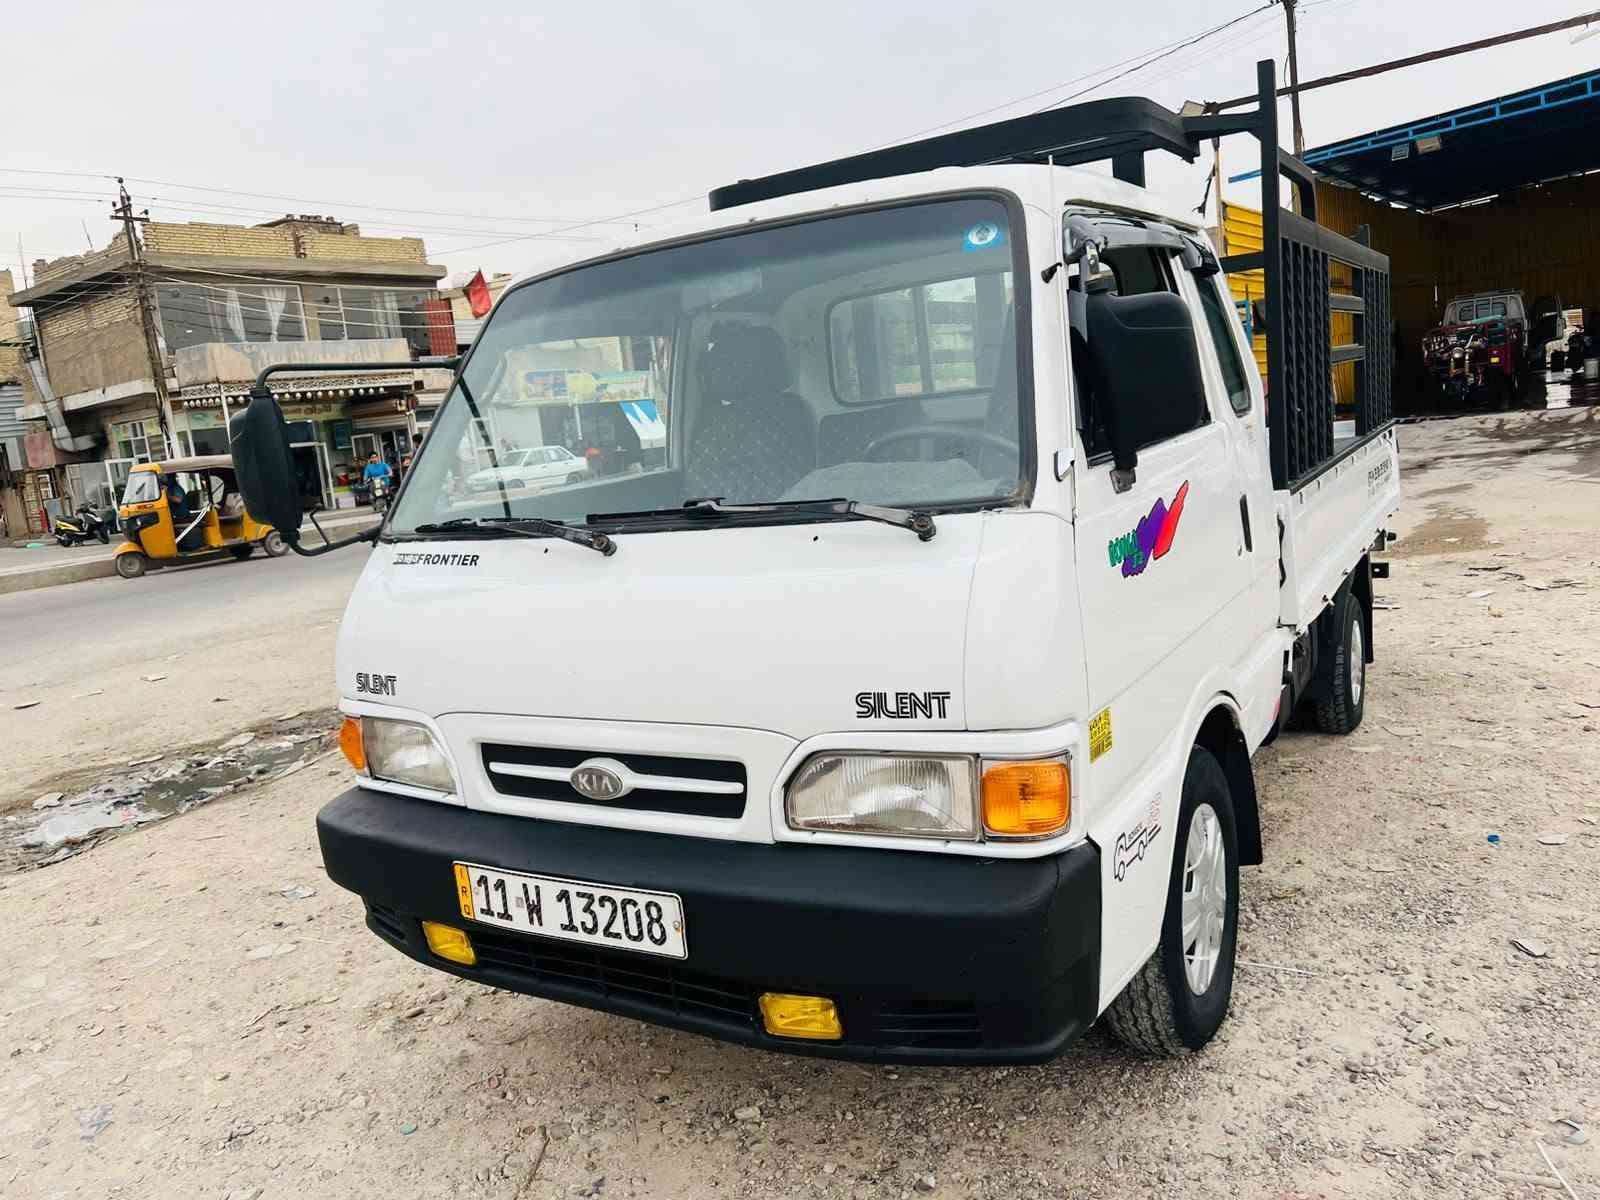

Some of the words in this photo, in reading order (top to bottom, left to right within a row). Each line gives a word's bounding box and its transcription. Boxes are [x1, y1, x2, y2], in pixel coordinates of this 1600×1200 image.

[416, 554, 480, 567] FRONTIER
[356, 672, 397, 696] SILENT
[855, 691, 951, 719] SILENT
[577, 773, 614, 793] KIA
[476, 874, 513, 921] 11
[522, 882, 543, 927] W
[556, 889, 667, 946] 13208
